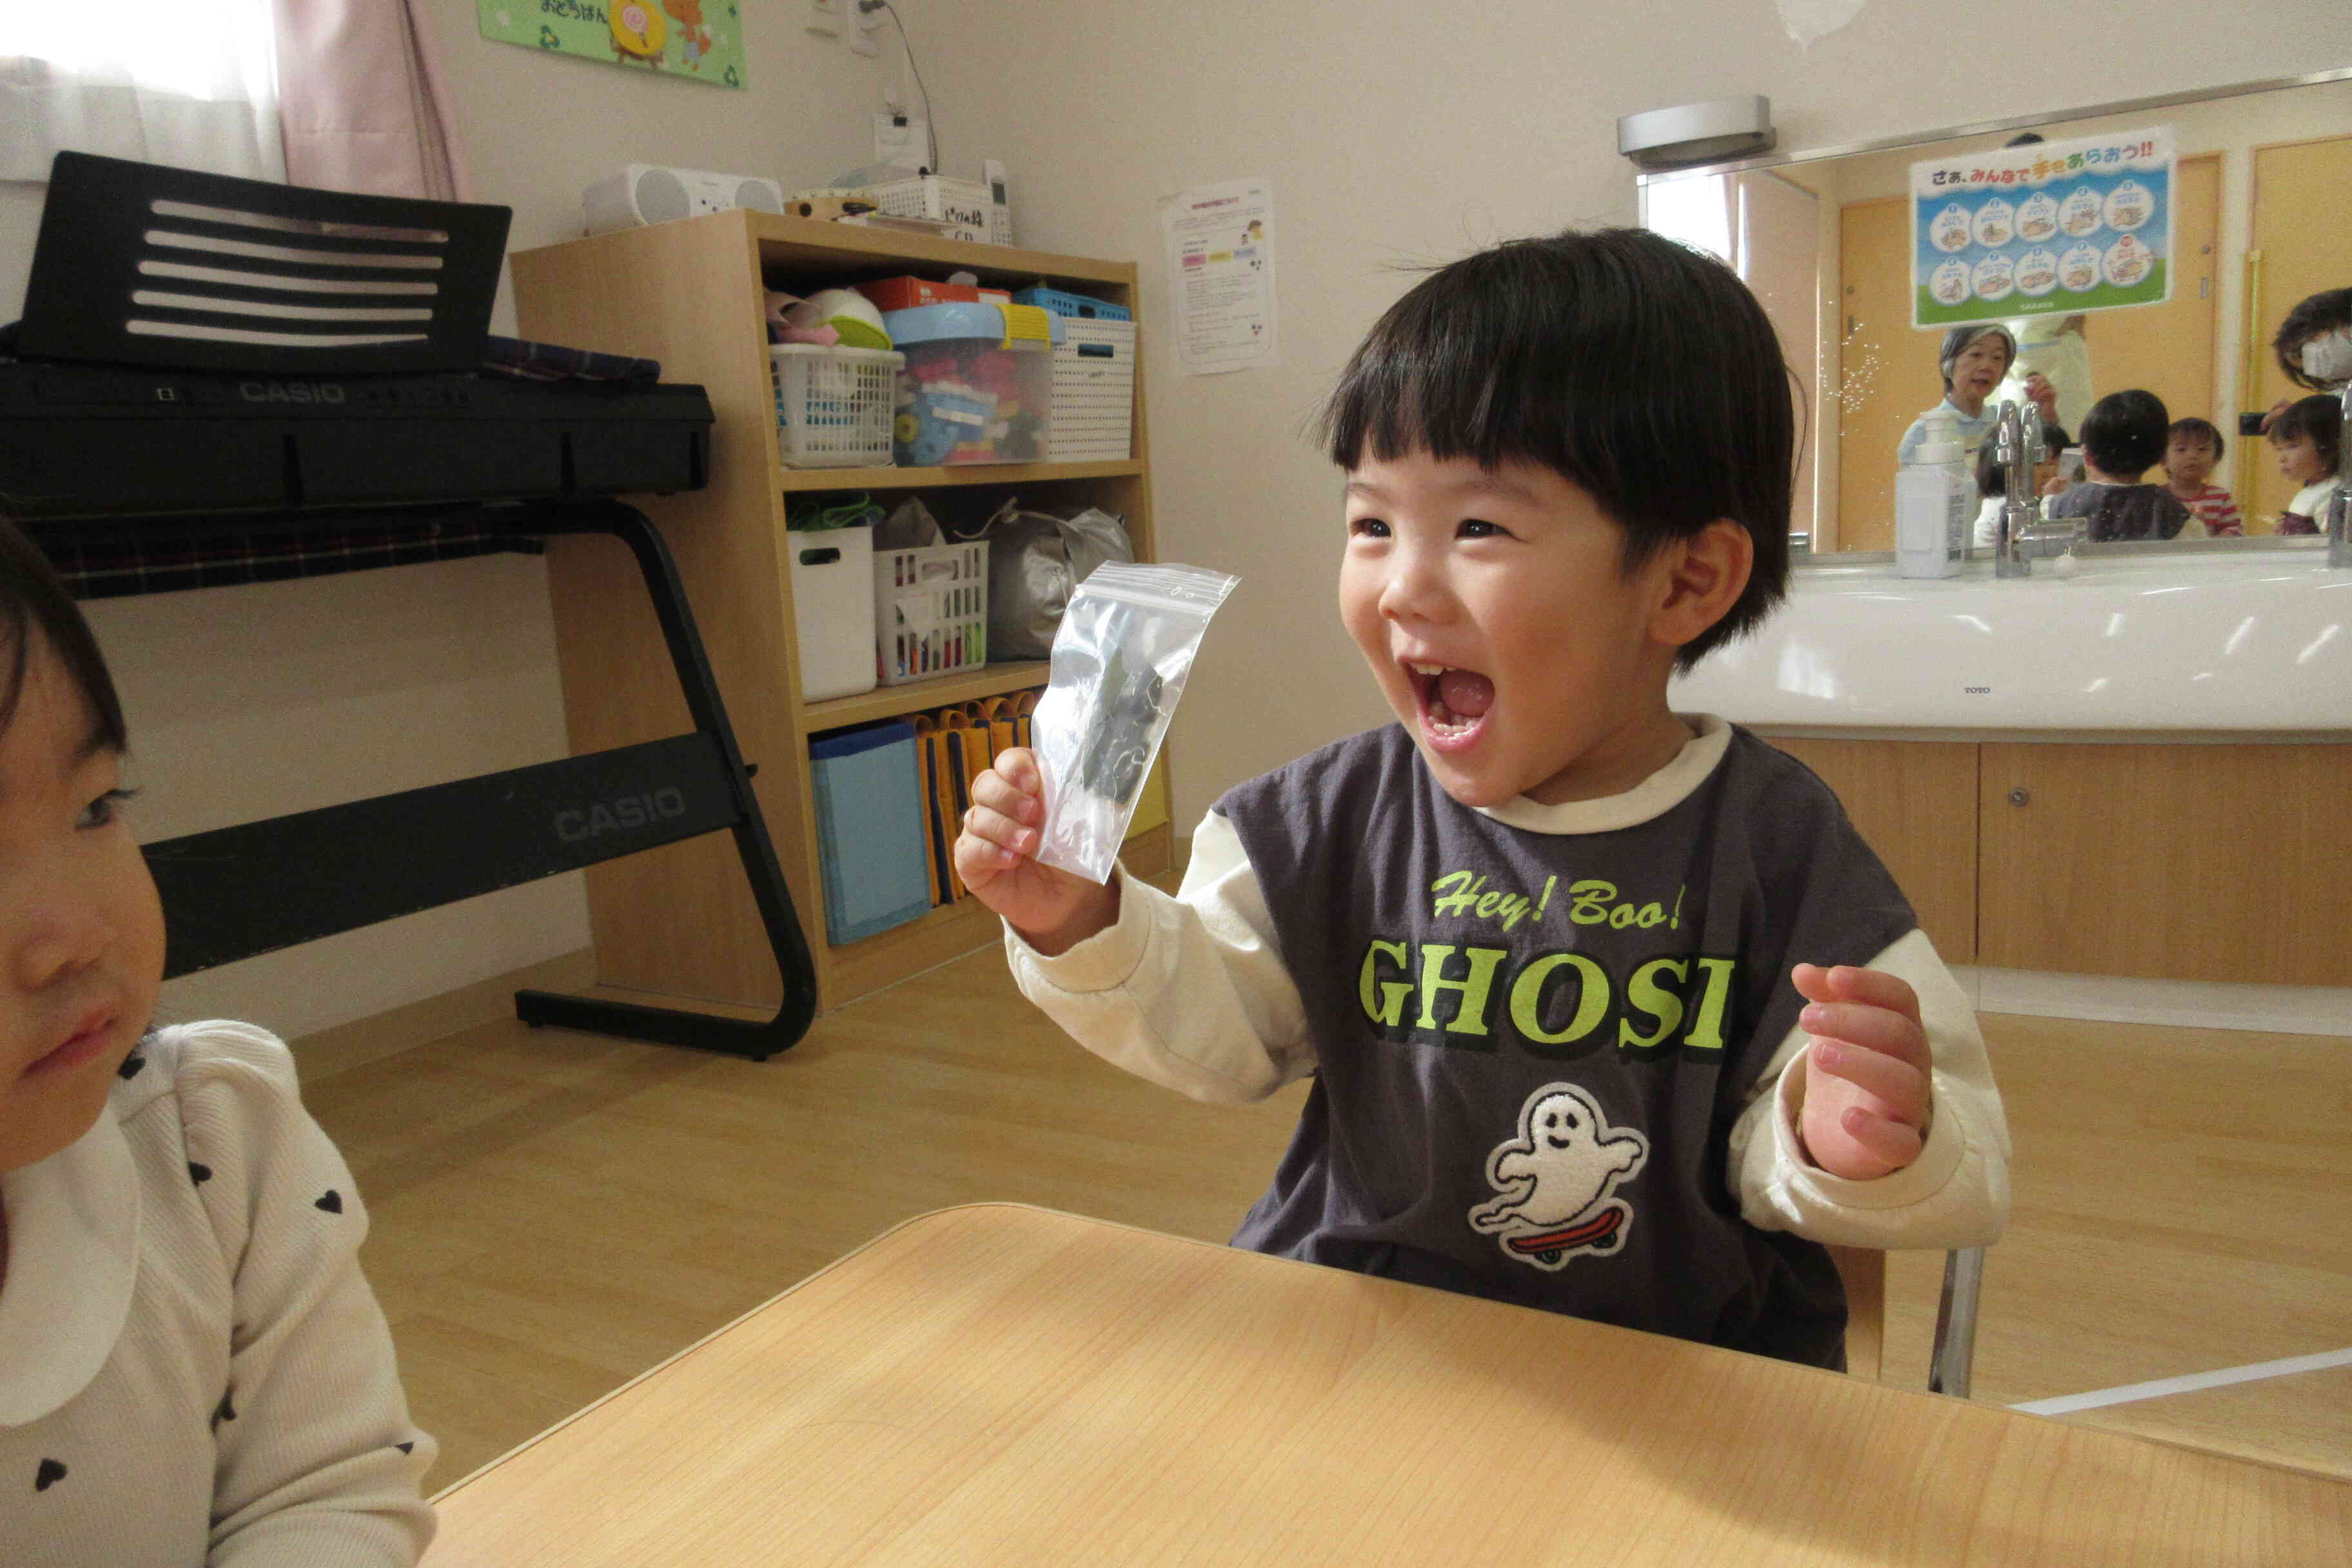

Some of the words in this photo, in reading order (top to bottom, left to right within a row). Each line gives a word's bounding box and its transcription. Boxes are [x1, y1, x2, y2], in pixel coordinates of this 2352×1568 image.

[239, 382, 346, 404] CASIO
[553, 786, 686, 841] CASIO
[1430, 870, 1558, 932] Hey!
[1568, 879, 1686, 930] Boo!
